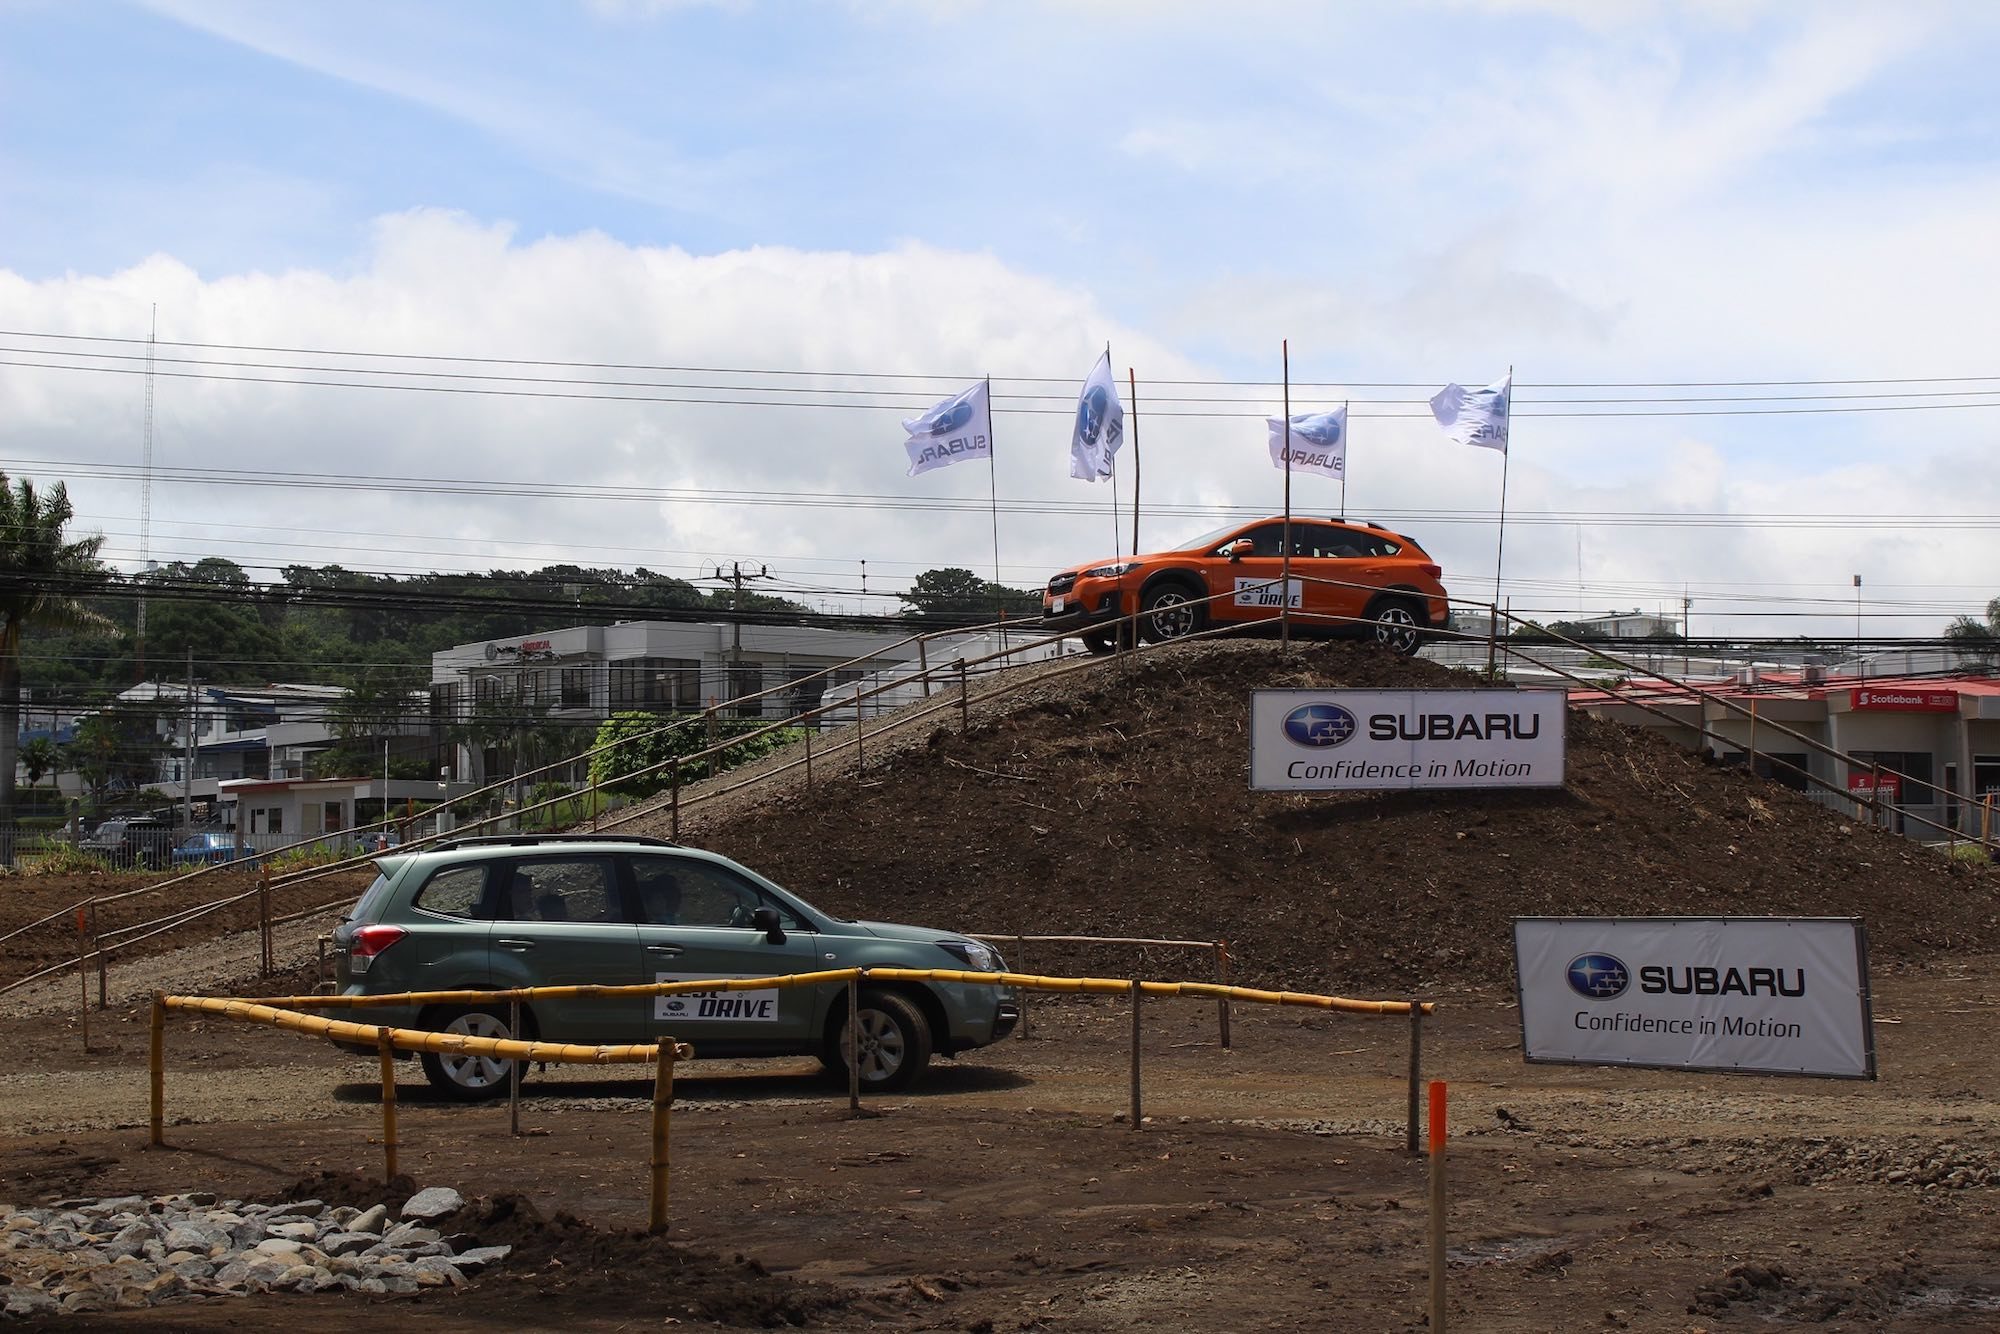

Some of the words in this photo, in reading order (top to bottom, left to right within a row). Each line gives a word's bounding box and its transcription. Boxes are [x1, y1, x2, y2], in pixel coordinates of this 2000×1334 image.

[1871, 694, 1924, 705] Scotiabank
[1369, 713, 1540, 741] SUBARU
[1287, 760, 1422, 779] Confidence
[1427, 759, 1448, 778] in
[1452, 758, 1532, 777] Motion
[1639, 966, 1806, 998] SUBARU
[697, 999, 775, 1018] DRIVE
[1574, 1011, 1693, 1035] Confidence
[1699, 1015, 1717, 1036] in
[1722, 1016, 1801, 1039] Motion
